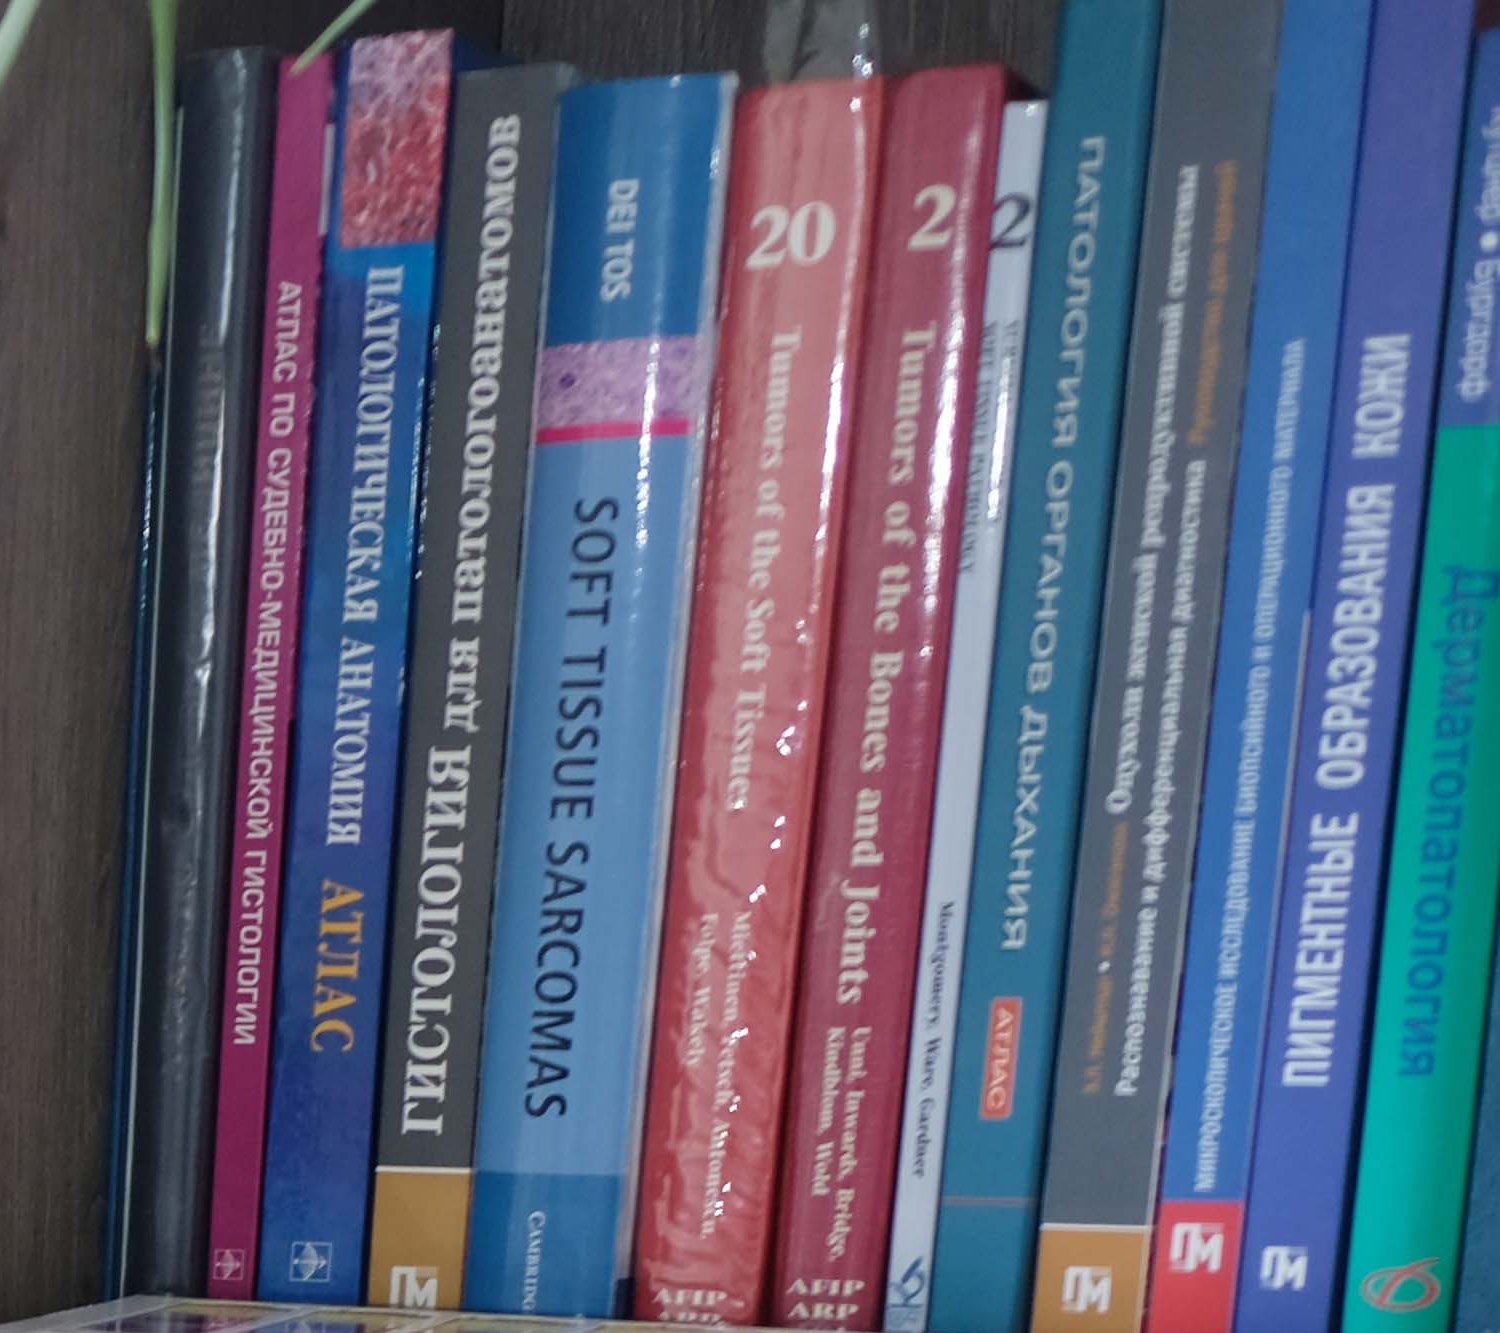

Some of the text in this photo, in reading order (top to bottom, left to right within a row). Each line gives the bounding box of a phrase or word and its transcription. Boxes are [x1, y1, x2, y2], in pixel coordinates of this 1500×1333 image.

[602, 178, 640, 300] DEI TOS
[746, 200, 836, 271] 20
[234, 281, 302, 1045] АТЛАС ПО СУДЕБНО-МЕДИЦИНСКОЙ ГИСТОЛОГИИ
[309, 264, 405, 1053] ПАТОЛОГИЧЕСКАЯ АНАТОМИЯ АТЛАС
[401, 112, 522, 1135] ГИСТОЛОГИЯ для патологоанатомов
[727, 325, 802, 810] Tumors of the Soft Tissues
[837, 321, 936, 1006] Tumors of the Bones and Joints
[1003, 136, 1107, 950] ПАТОЛОГИЯ ОРГАНОВ ДЫХАНИЯ
[1282, 333, 1412, 1087] ПИГМЕНТНЫЕ ОБРАЗОВАНИЯ КОЖИ
[525, 499, 619, 1118] SOFT TISSUE SARCOMAS
[1114, 907, 1156, 1098] Распознавание
[1400, 564, 1500, 1079] Дерматопатология
[653, 1288, 728, 1307] AFIP
[786, 1278, 866, 1296] AFIP
[911, 1096, 938, 1180] Gardner
[986, 1004, 1016, 1112] АТЛАС
[787, 1301, 860, 1321] ARP
